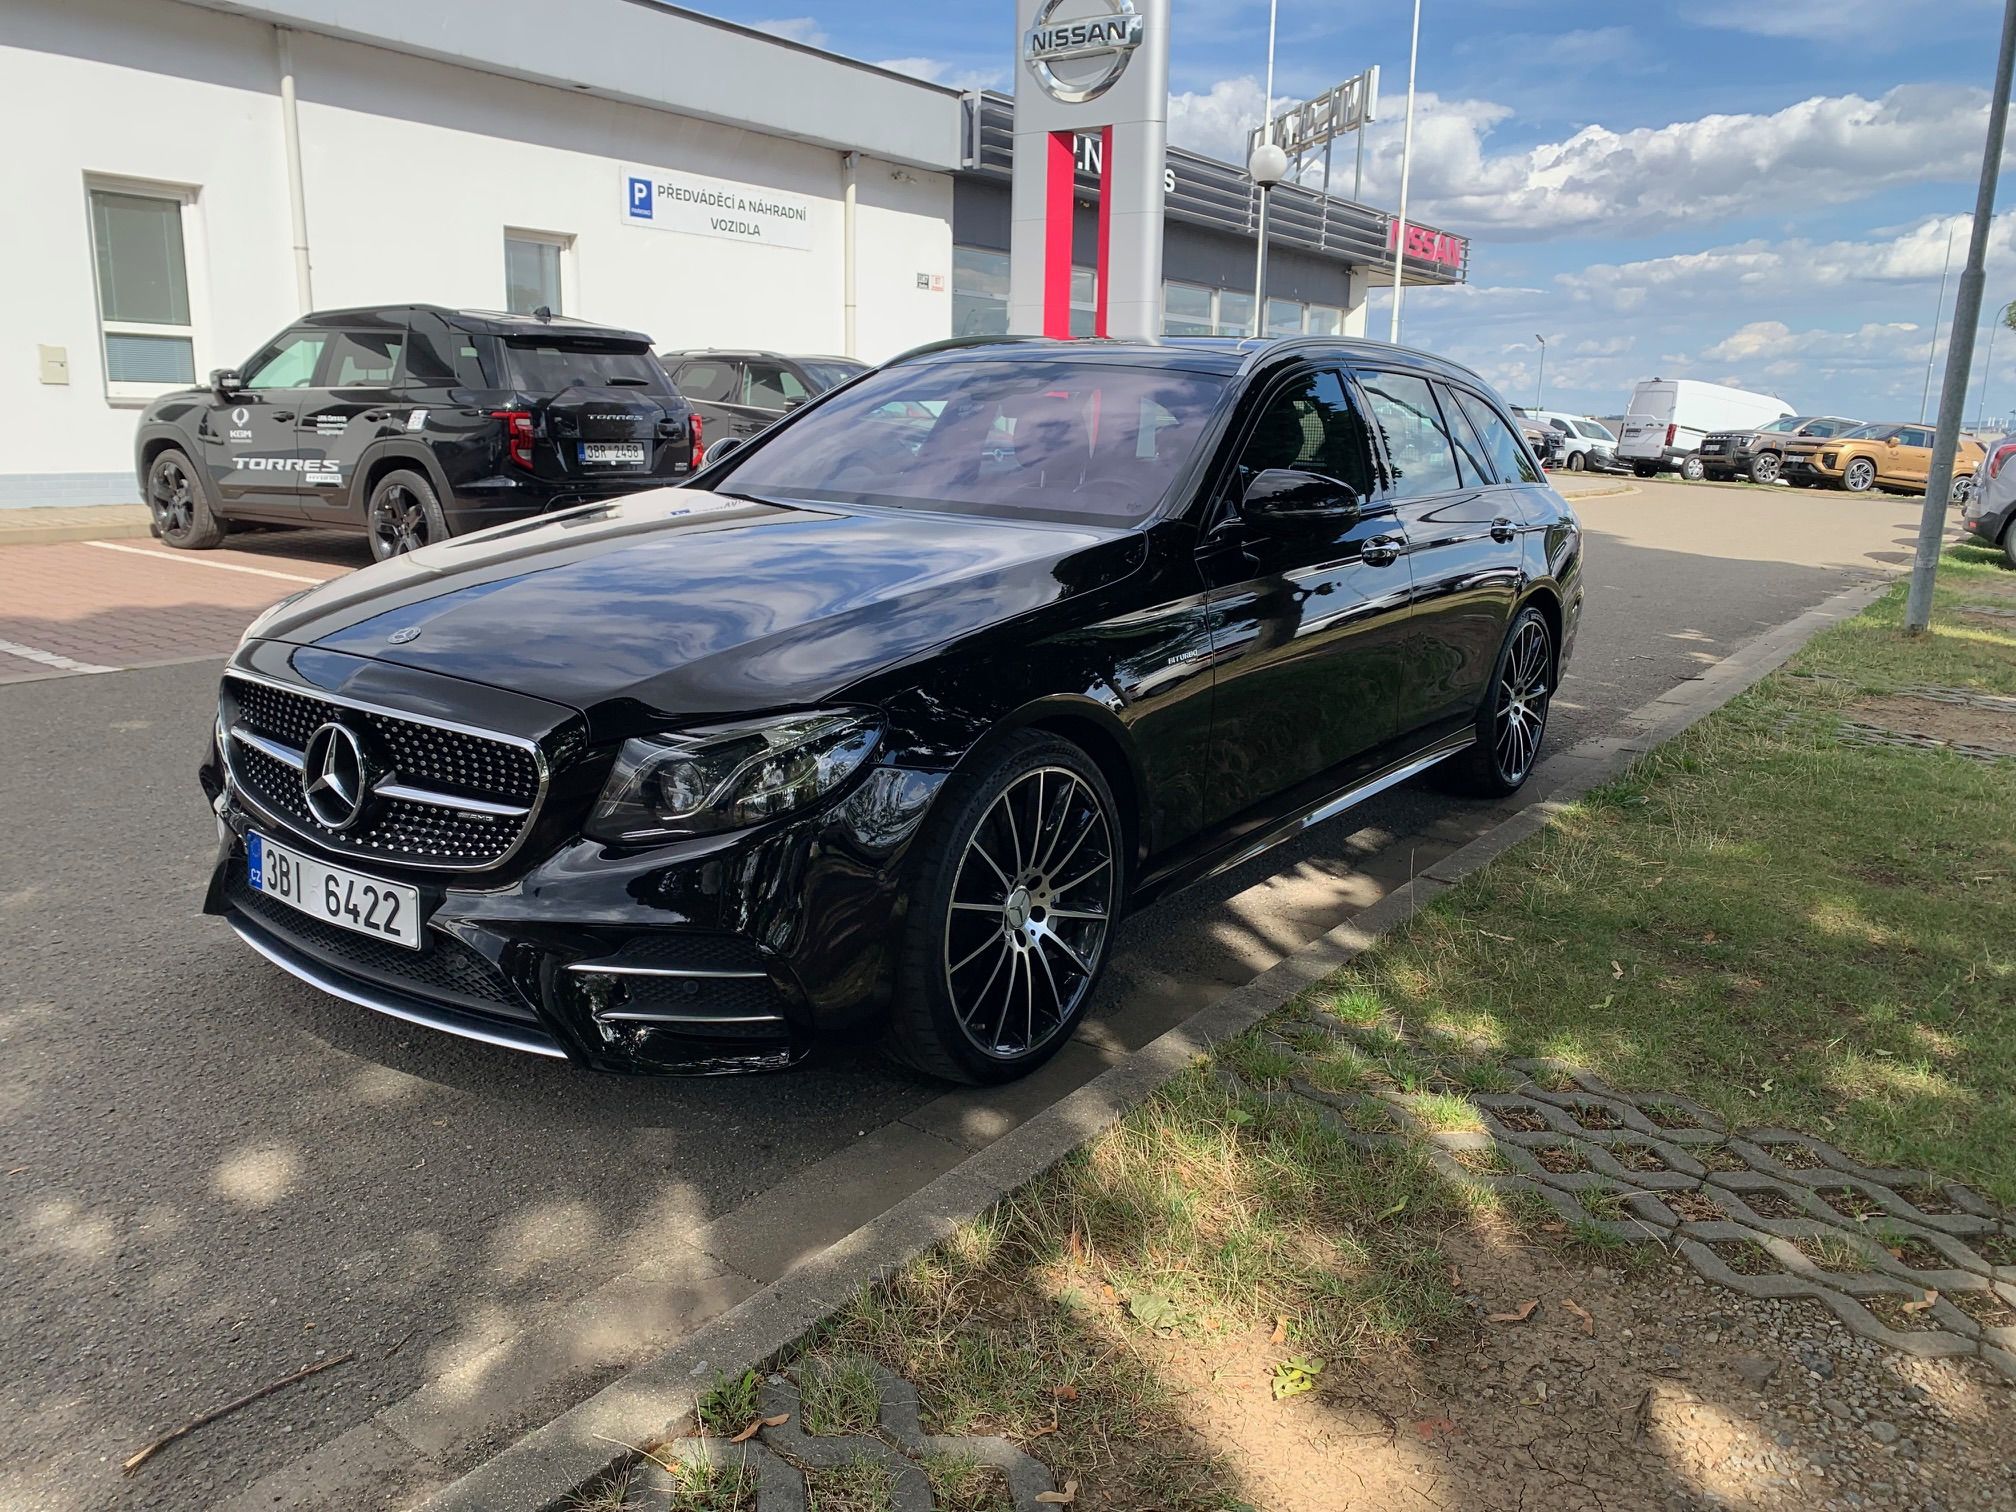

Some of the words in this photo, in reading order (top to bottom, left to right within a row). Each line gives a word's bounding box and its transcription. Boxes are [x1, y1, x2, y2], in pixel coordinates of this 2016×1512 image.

[1032, 21, 1126, 52] NISSAN
[634, 182, 647, 206] P
[658, 183, 736, 209] PŘEDVÁDĚCÍ
[737, 200, 746, 212] A
[748, 201, 807, 221] NÁHRADNÍ
[711, 217, 758, 237] VOZIDLA
[587, 413, 643, 421] TORRES
[229, 429, 252, 438] KGM
[232, 457, 340, 472] TORRES
[1168, 649, 1198, 664] BITURBO
[469, 813, 494, 822] AMG
[250, 868, 262, 883] CZ
[266, 849, 301, 904] 3BI
[324, 873, 401, 937] 6422
